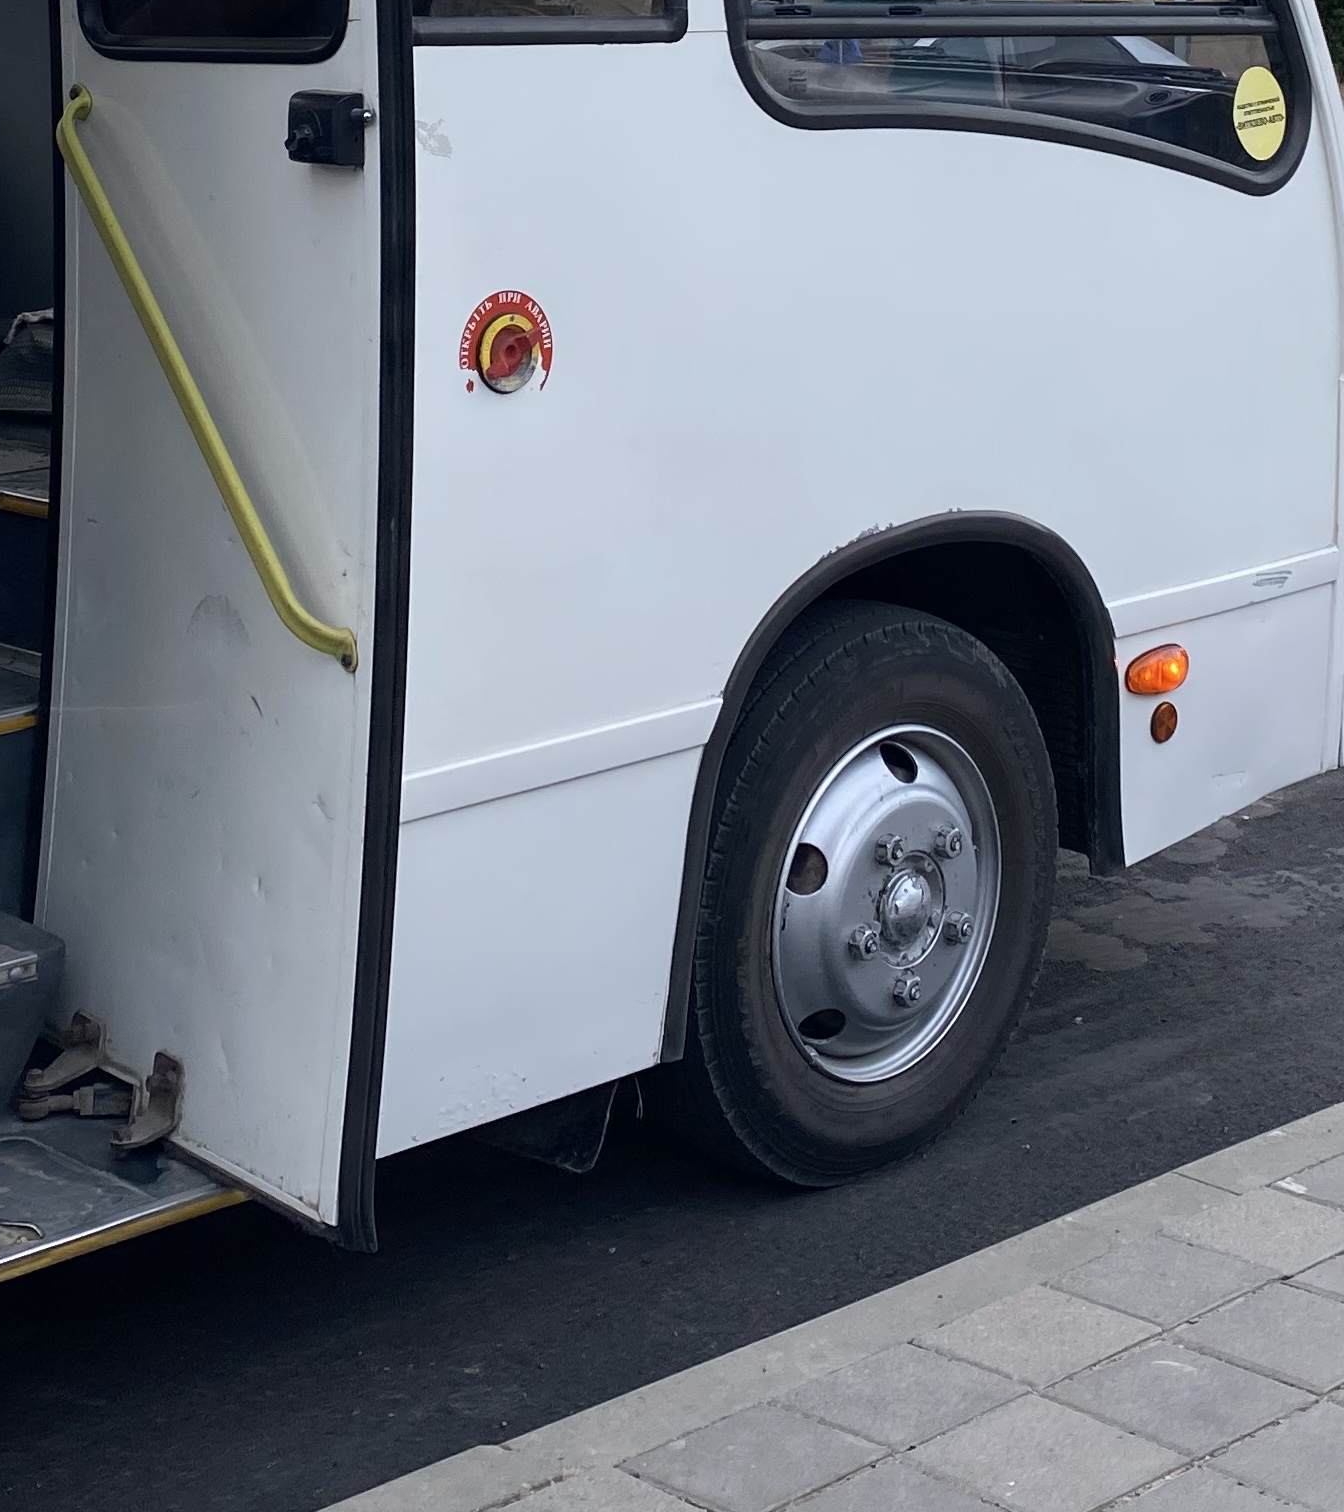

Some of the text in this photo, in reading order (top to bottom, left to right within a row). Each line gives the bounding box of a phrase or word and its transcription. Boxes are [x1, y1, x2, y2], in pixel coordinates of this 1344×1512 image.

[460, 300, 493, 369] ОТКРЫТЬ
[498, 291, 522, 304] ПРИ
[524, 301, 552, 349] АВАРИИ
